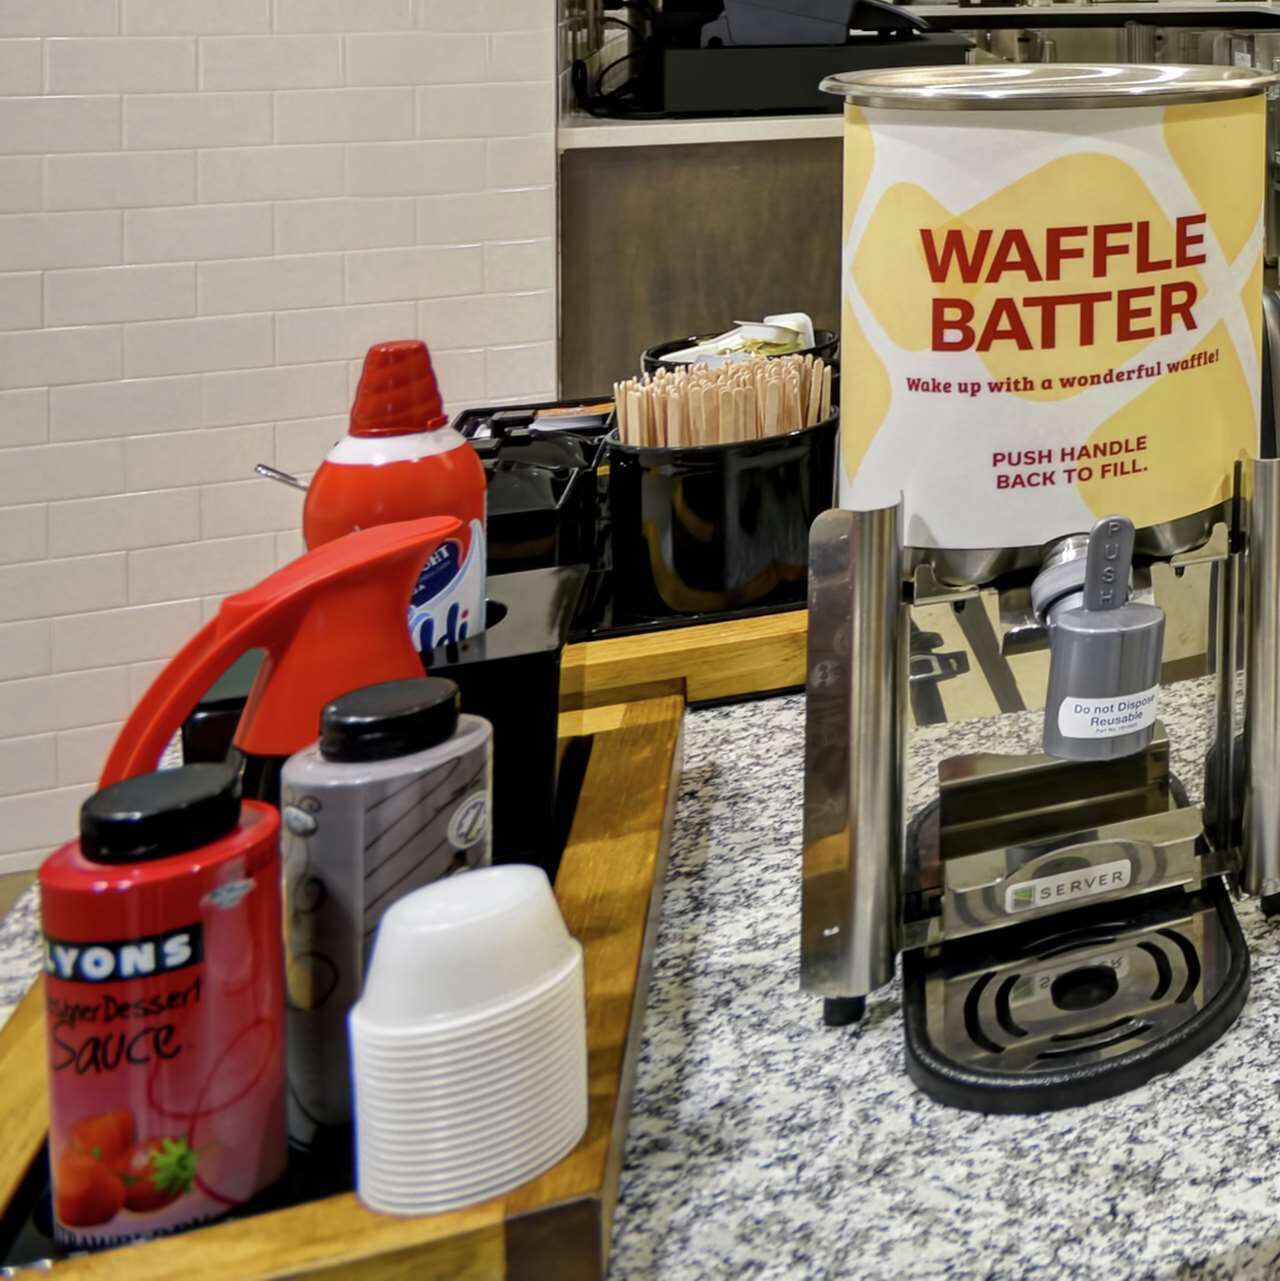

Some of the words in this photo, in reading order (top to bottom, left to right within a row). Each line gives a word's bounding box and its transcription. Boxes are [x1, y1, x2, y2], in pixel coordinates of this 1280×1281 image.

[919, 213, 1207, 284] WAFFLE
[931, 280, 1198, 352] BATTER
[906, 376, 952, 393] Wake
[957, 380, 981, 397] up
[987, 376, 1035, 393] with
[1041, 378, 1054, 391] a
[1059, 361, 1162, 390] wonderful
[1166, 349, 1220, 374] waffle!
[992, 449, 1053, 468] PUSH
[1060, 435, 1148, 462] HANDLE
[996, 470, 1056, 489] BACK
[1063, 466, 1093, 484] TO
[1100, 459, 1148, 479] FILL.
[1101, 521, 1121, 606] PUSH
[1074, 703, 1091, 715] Do
[1094, 704, 1115, 715] not
[1090, 711, 1143, 727] Reusable
[1039, 871, 1123, 900] SERVER
[50, 1023, 183, 1075] Sauce
